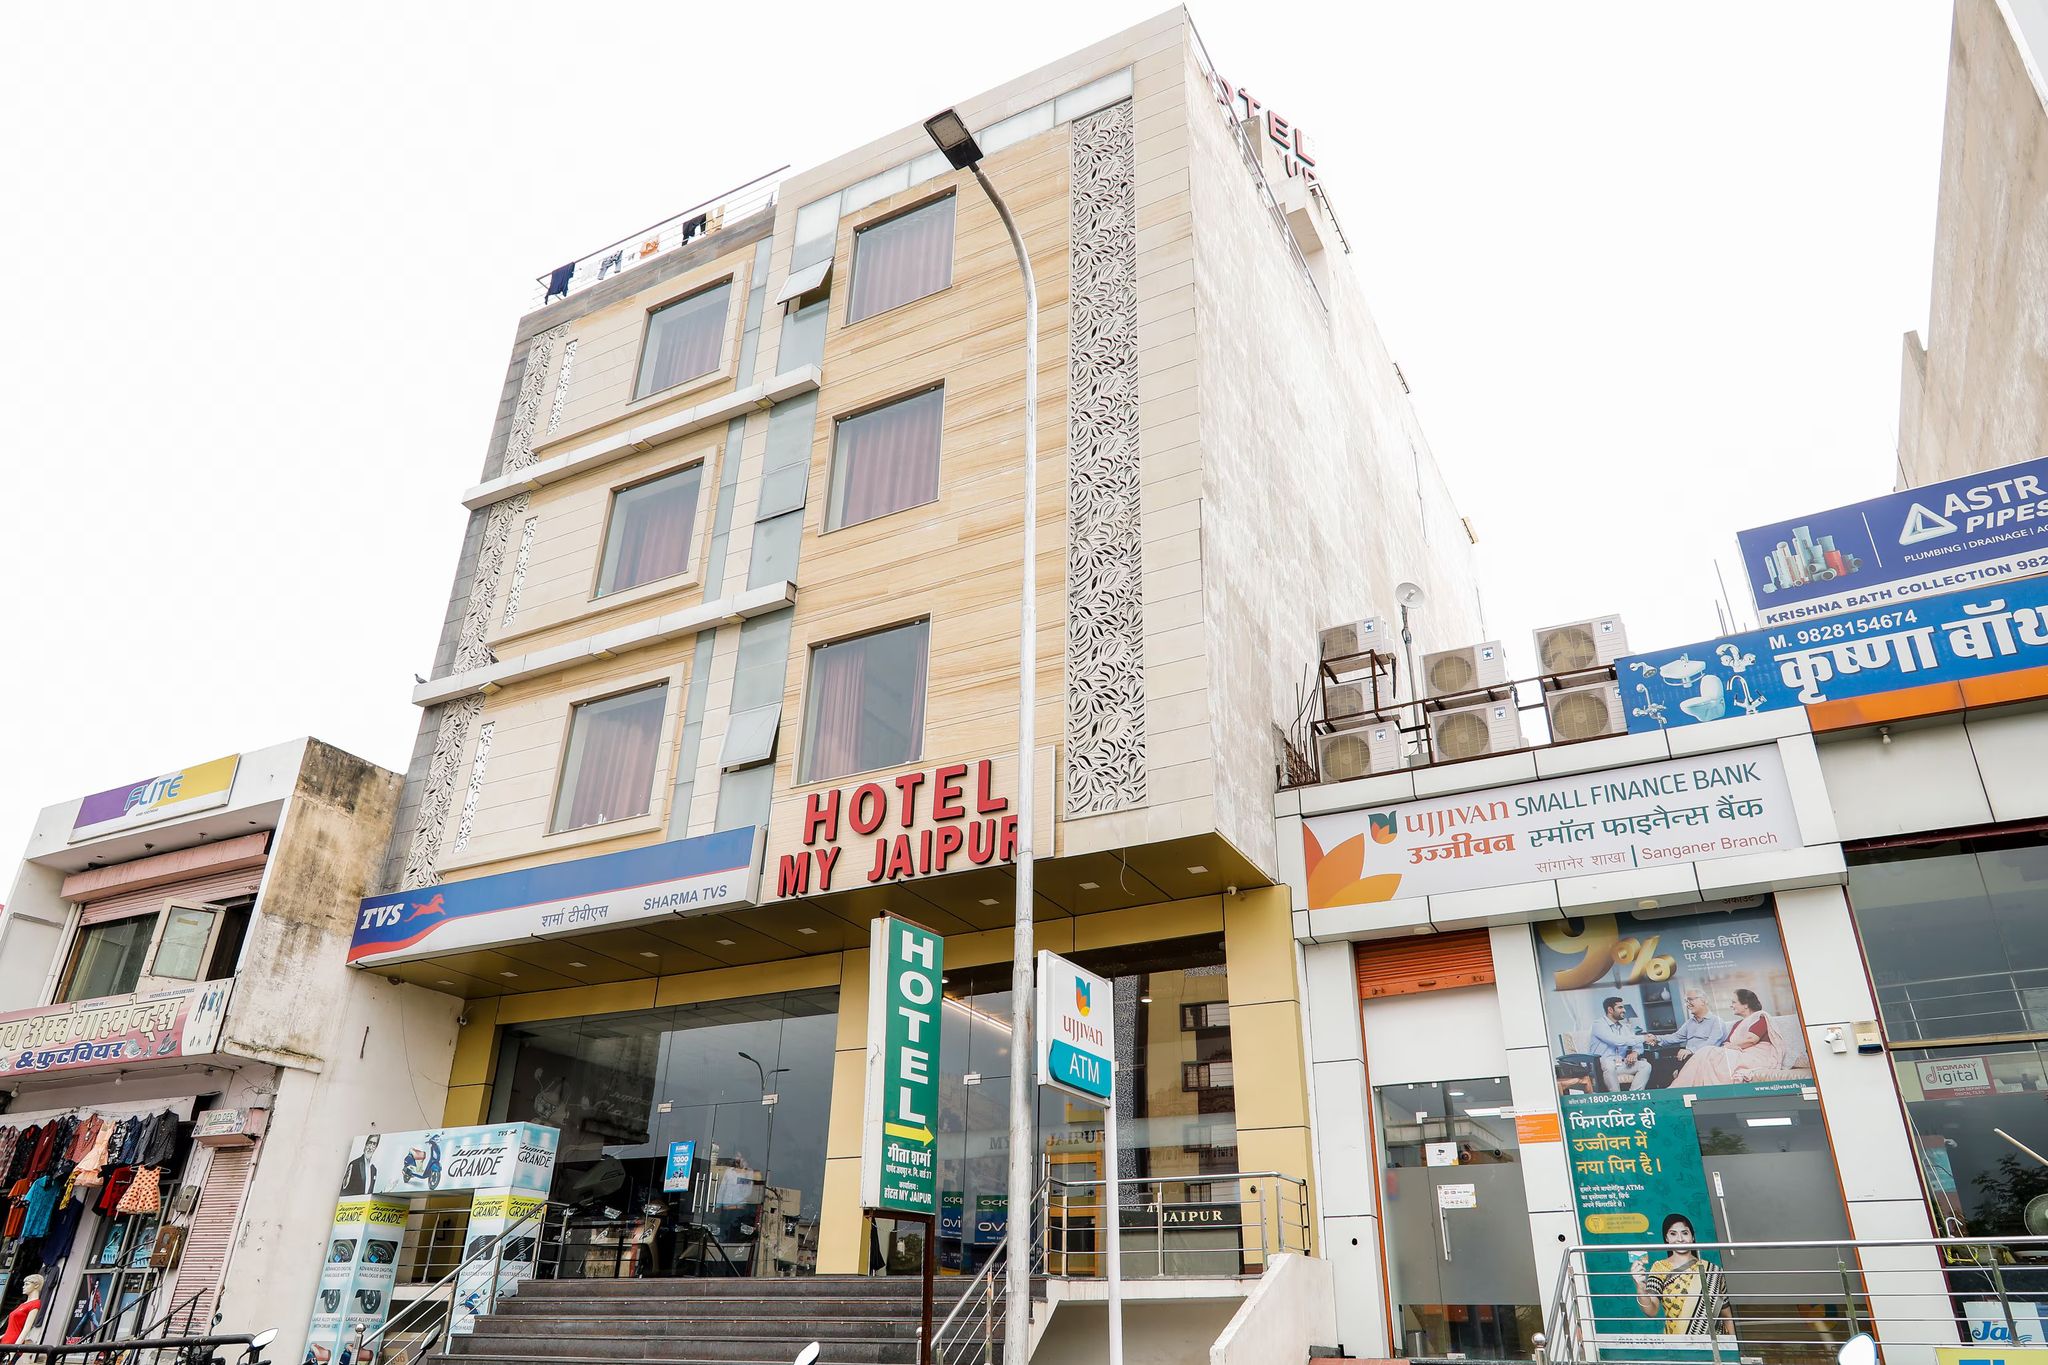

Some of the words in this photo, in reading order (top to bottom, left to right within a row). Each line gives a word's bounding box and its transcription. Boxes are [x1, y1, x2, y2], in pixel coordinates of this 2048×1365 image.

[1904, 543, 1962, 563] PLUMBING
[1968, 529, 2029, 548] DRAINAGE
[1766, 600, 1842, 625] KRISHNA
[1845, 589, 1893, 607] BATH
[1897, 563, 2012, 595] COLLECTION
[1769, 634, 1793, 650] M.
[1797, 609, 1918, 645] 9828154674
[1773, 625, 1939, 705] कृष्णा
[123, 774, 184, 812] FLITE
[802, 758, 1009, 846] HOTEL
[1515, 787, 1588, 817] SMALL
[1590, 773, 1688, 806] FINANCE
[1692, 761, 1762, 791] BANK
[1407, 832, 1516, 866] उज्जीवन
[1528, 818, 1596, 848] स्मॉल
[1716, 794, 1764, 821] बैंक
[776, 846, 842, 897] MY
[867, 814, 1018, 883] JAIPUR
[1641, 839, 1716, 860] Sanganer
[1720, 831, 1778, 850] Branch
[1535, 855, 1584, 873] सांगानेर
[1592, 851, 1626, 867] शाखा
[643, 889, 699, 911] SHARMA
[702, 883, 728, 900] TVS
[360, 902, 405, 930] TVS
[541, 909, 564, 928] शर्मा
[567, 904, 609, 923] टीवीएस
[1684, 952, 1698, 962] पर
[0, 1018, 30, 1051] य
[898, 929, 935, 1124] HOTEL
[1069, 1051, 1101, 1086] ATM
[1935, 1062, 1977, 1072] SOMANY
[1588, 1092, 1651, 1104] 1800-208-2121
[1569, 1107, 1636, 1130] फिंगरप्रिंट
[1638, 1107, 1656, 1129] ही
[1634, 1130, 1648, 1149] में
[447, 1156, 504, 1178] GRANDE
[517, 1150, 553, 1168] GRANDE
[1576, 1160, 1604, 1175] नया
[1607, 1154, 1636, 1174] पिन
[335, 1211, 364, 1223] GRANDE
[369, 1211, 405, 1225] GRANDE
[472, 1205, 502, 1218] GRANDE
[1163, 1210, 1223, 1223] JAIPUR
